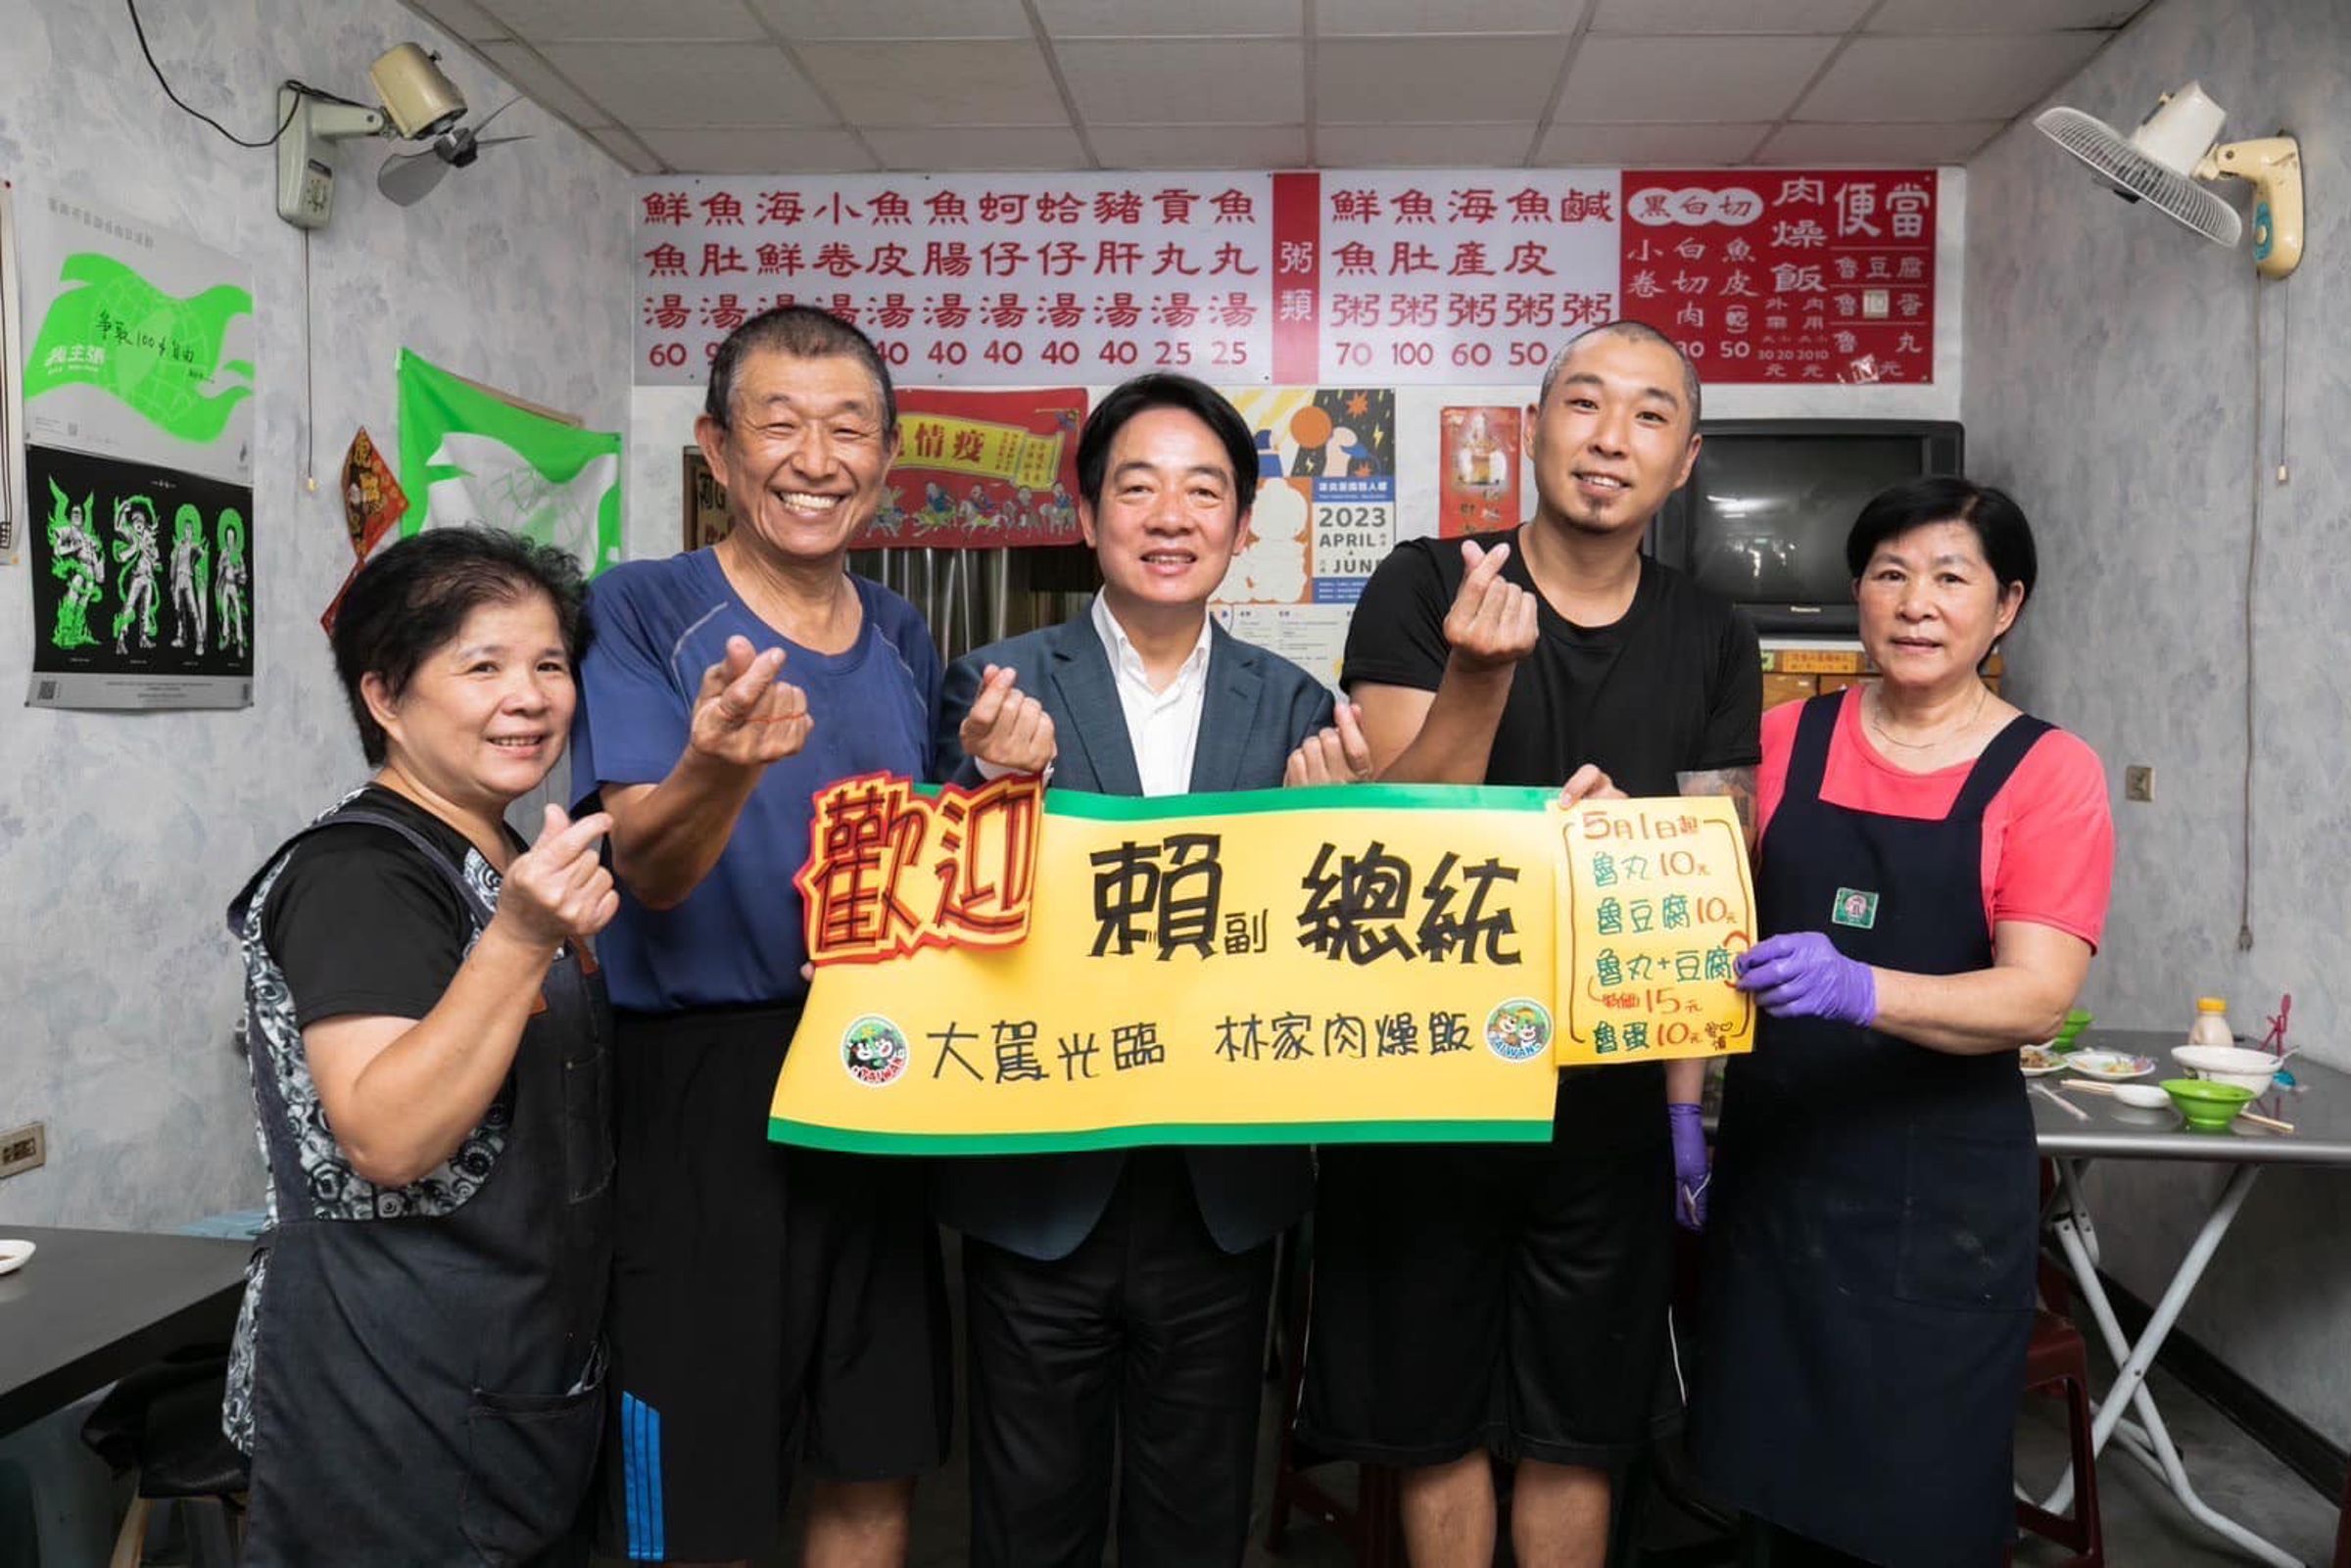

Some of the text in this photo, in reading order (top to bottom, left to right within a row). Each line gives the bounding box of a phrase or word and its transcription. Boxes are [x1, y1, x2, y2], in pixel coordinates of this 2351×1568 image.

[1834, 182, 1930, 238] 便當
[1769, 176, 1829, 294] 肉燥飯
[1627, 239, 1665, 298] 小卷
[1279, 241, 1313, 321] 粥類
[648, 343, 687, 367] 60
[928, 341, 968, 366] 40
[984, 341, 1024, 365] 40
[1041, 341, 1080, 365] 40
[1099, 341, 1138, 365] 40
[1155, 341, 1192, 365] 25
[1211, 341, 1248, 365] 25
[1336, 343, 1373, 366] 70
[1392, 343, 1434, 366] 100
[1451, 343, 1493, 366] 60
[1508, 343, 1549, 366] 50
[1720, 341, 1751, 358] 50
[1319, 507, 1386, 528] 2023
[1319, 533, 1376, 547] APRIL
[811, 783, 1036, 956] 歡迎
[927, 1011, 1473, 1084] 大駕光臨 林家肉燥飯
